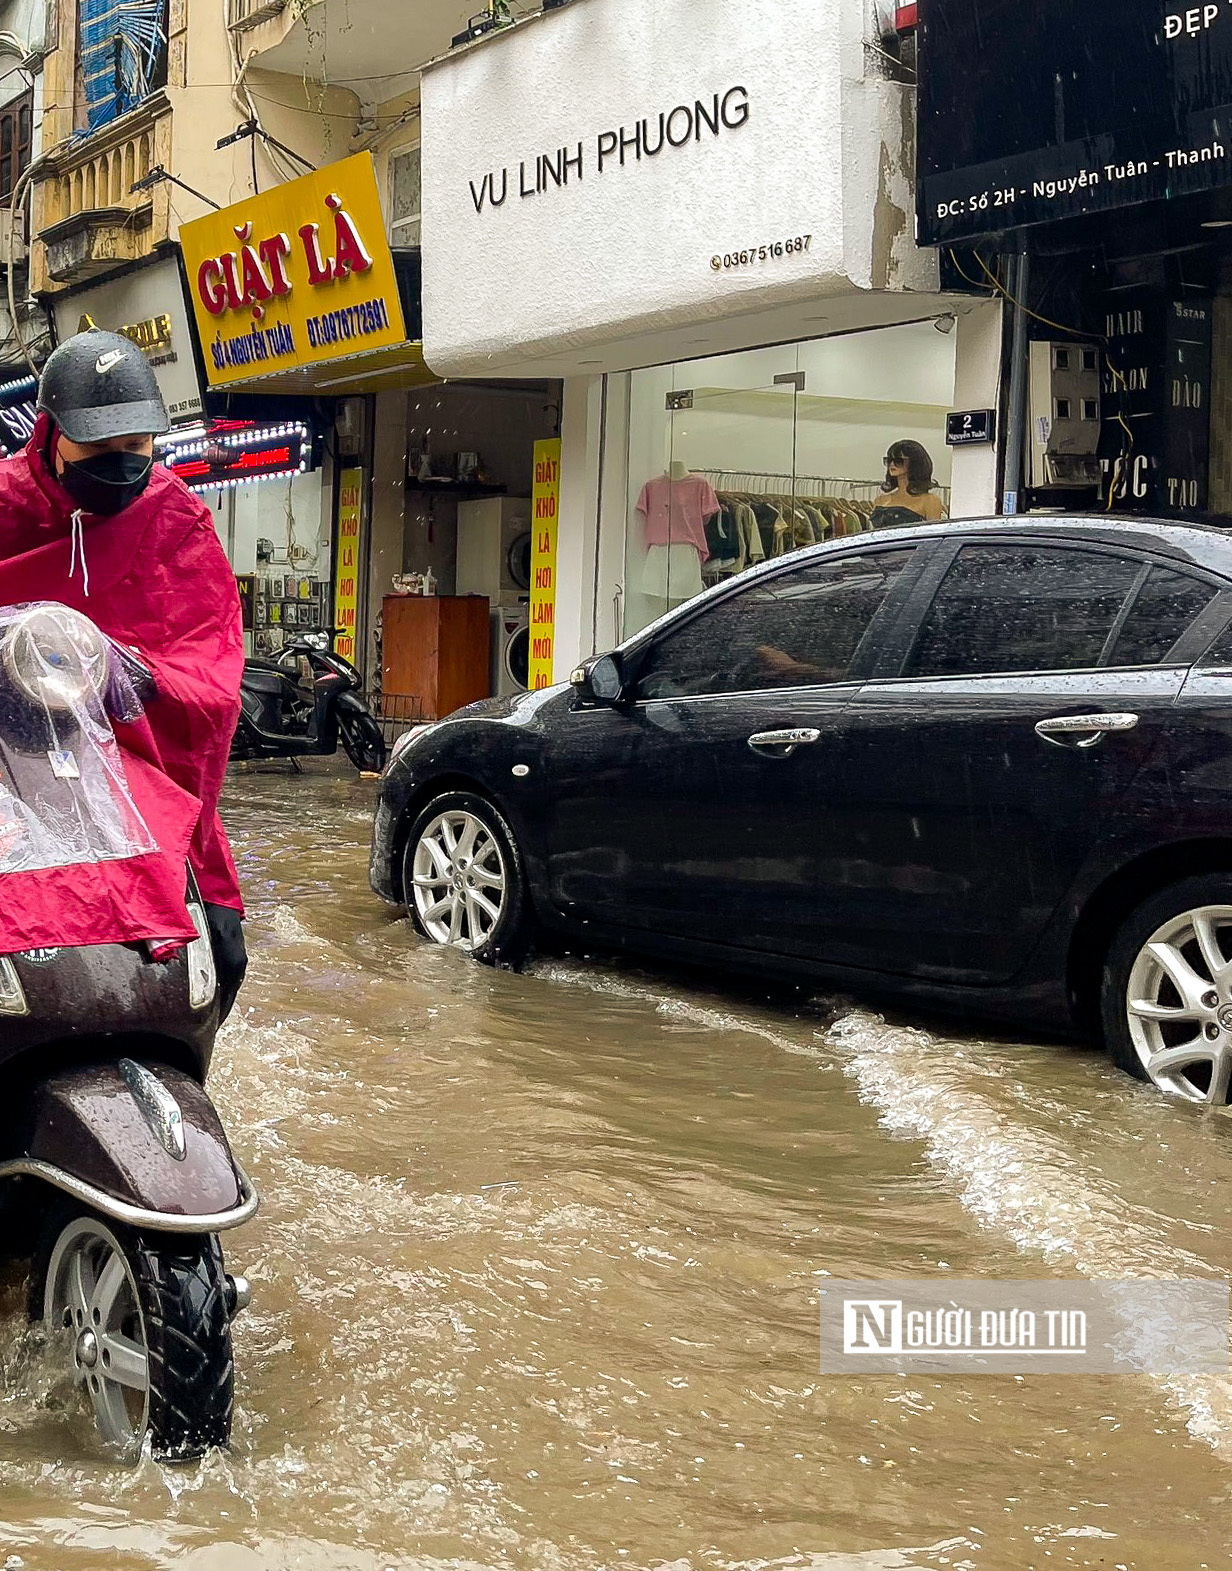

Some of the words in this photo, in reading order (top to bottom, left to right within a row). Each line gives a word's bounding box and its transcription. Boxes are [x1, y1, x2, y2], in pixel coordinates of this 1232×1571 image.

[1164, 4, 1218, 38] ĐẸP
[469, 168, 507, 213] VU
[520, 141, 583, 197] LINH
[598, 86, 750, 173] PHUONG
[937, 200, 964, 218] ĐC:
[969, 191, 989, 210] Số
[994, 188, 1015, 206] 2H
[1033, 170, 1099, 198] Nguyễn
[1104, 160, 1148, 181] Tuân
[1165, 142, 1225, 168] Thanh
[785, 234, 813, 254] 687
[198, 220, 293, 320] GIẶT
[1106, 309, 1144, 338] HAIR
[962, 415, 972, 429] 2
[535, 456, 558, 488] GIẶT
[535, 491, 555, 519] KHÔ
[538, 527, 550, 554] LÀ
[535, 567, 552, 590] HƠI
[532, 598, 553, 625] LÀM
[532, 632, 551, 660] MỚI
